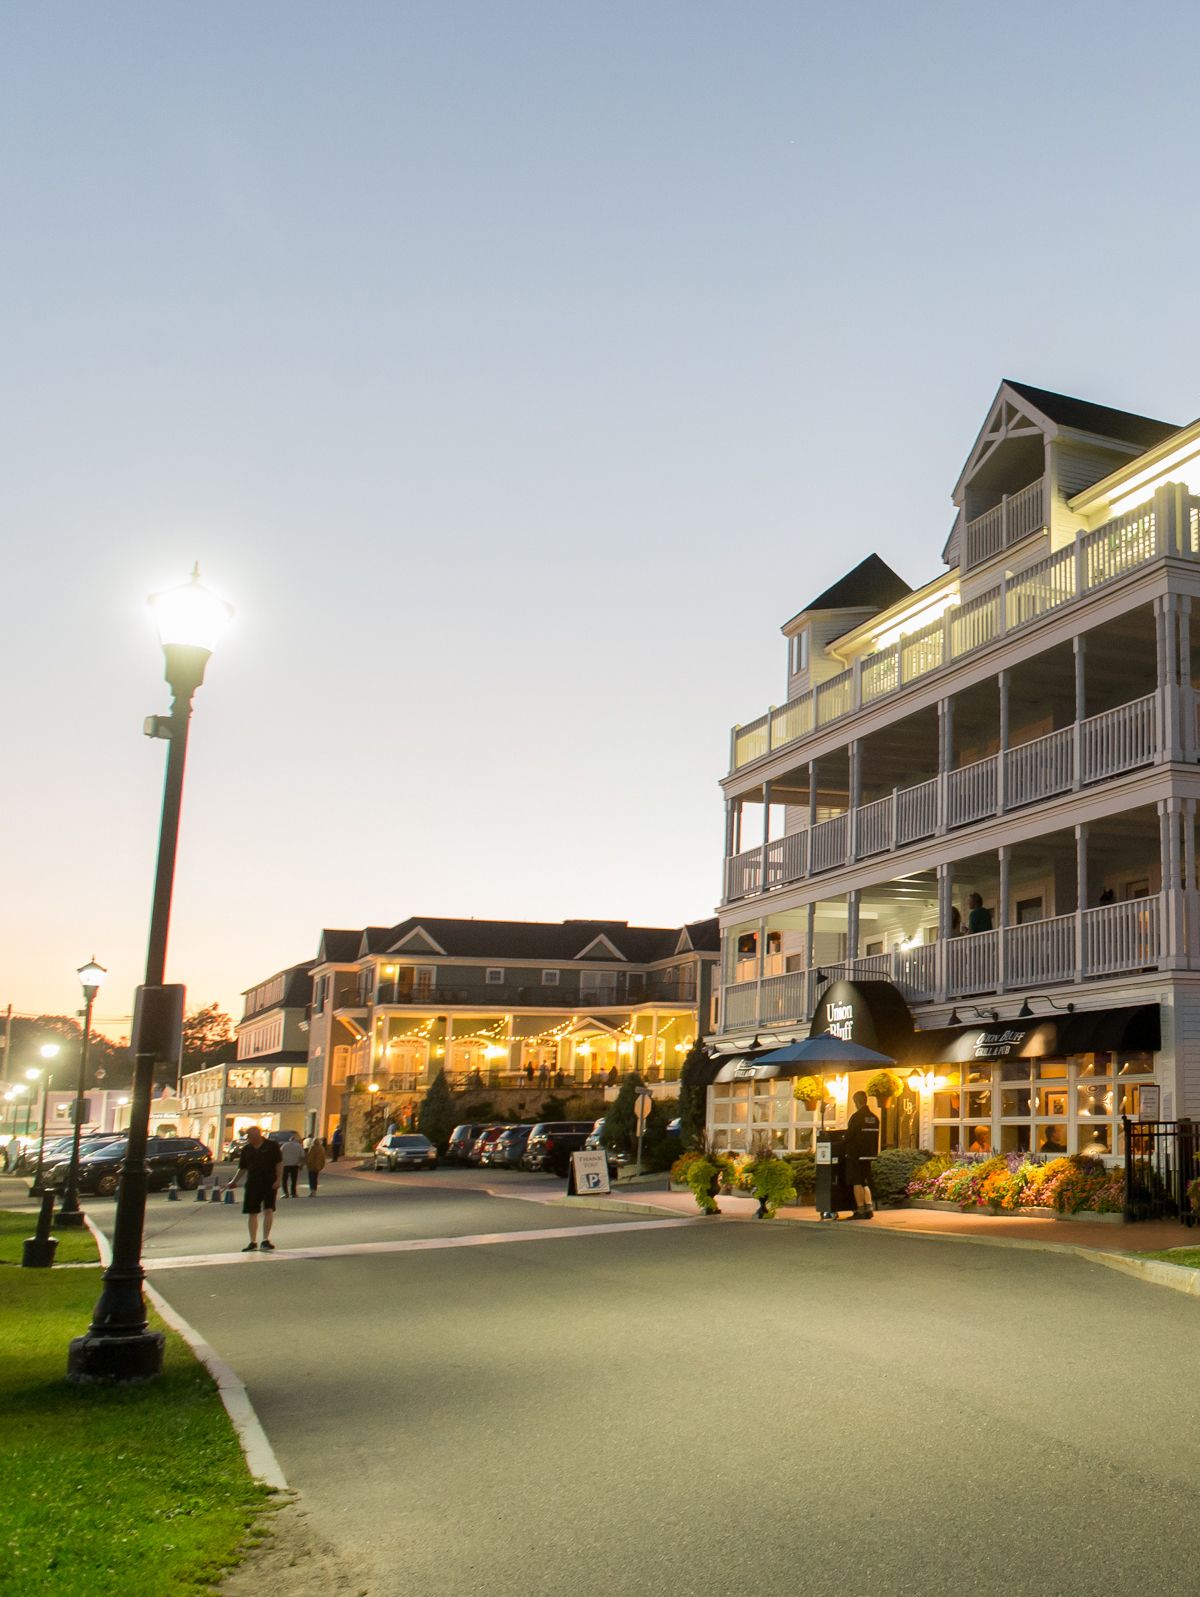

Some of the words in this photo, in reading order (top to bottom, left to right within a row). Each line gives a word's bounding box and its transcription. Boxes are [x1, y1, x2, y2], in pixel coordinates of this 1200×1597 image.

[826, 1000, 853, 1022] Union
[829, 1020, 854, 1041] Bluff
[975, 1032, 1000, 1045] UNION
[999, 1030, 1026, 1042] BLUFF
